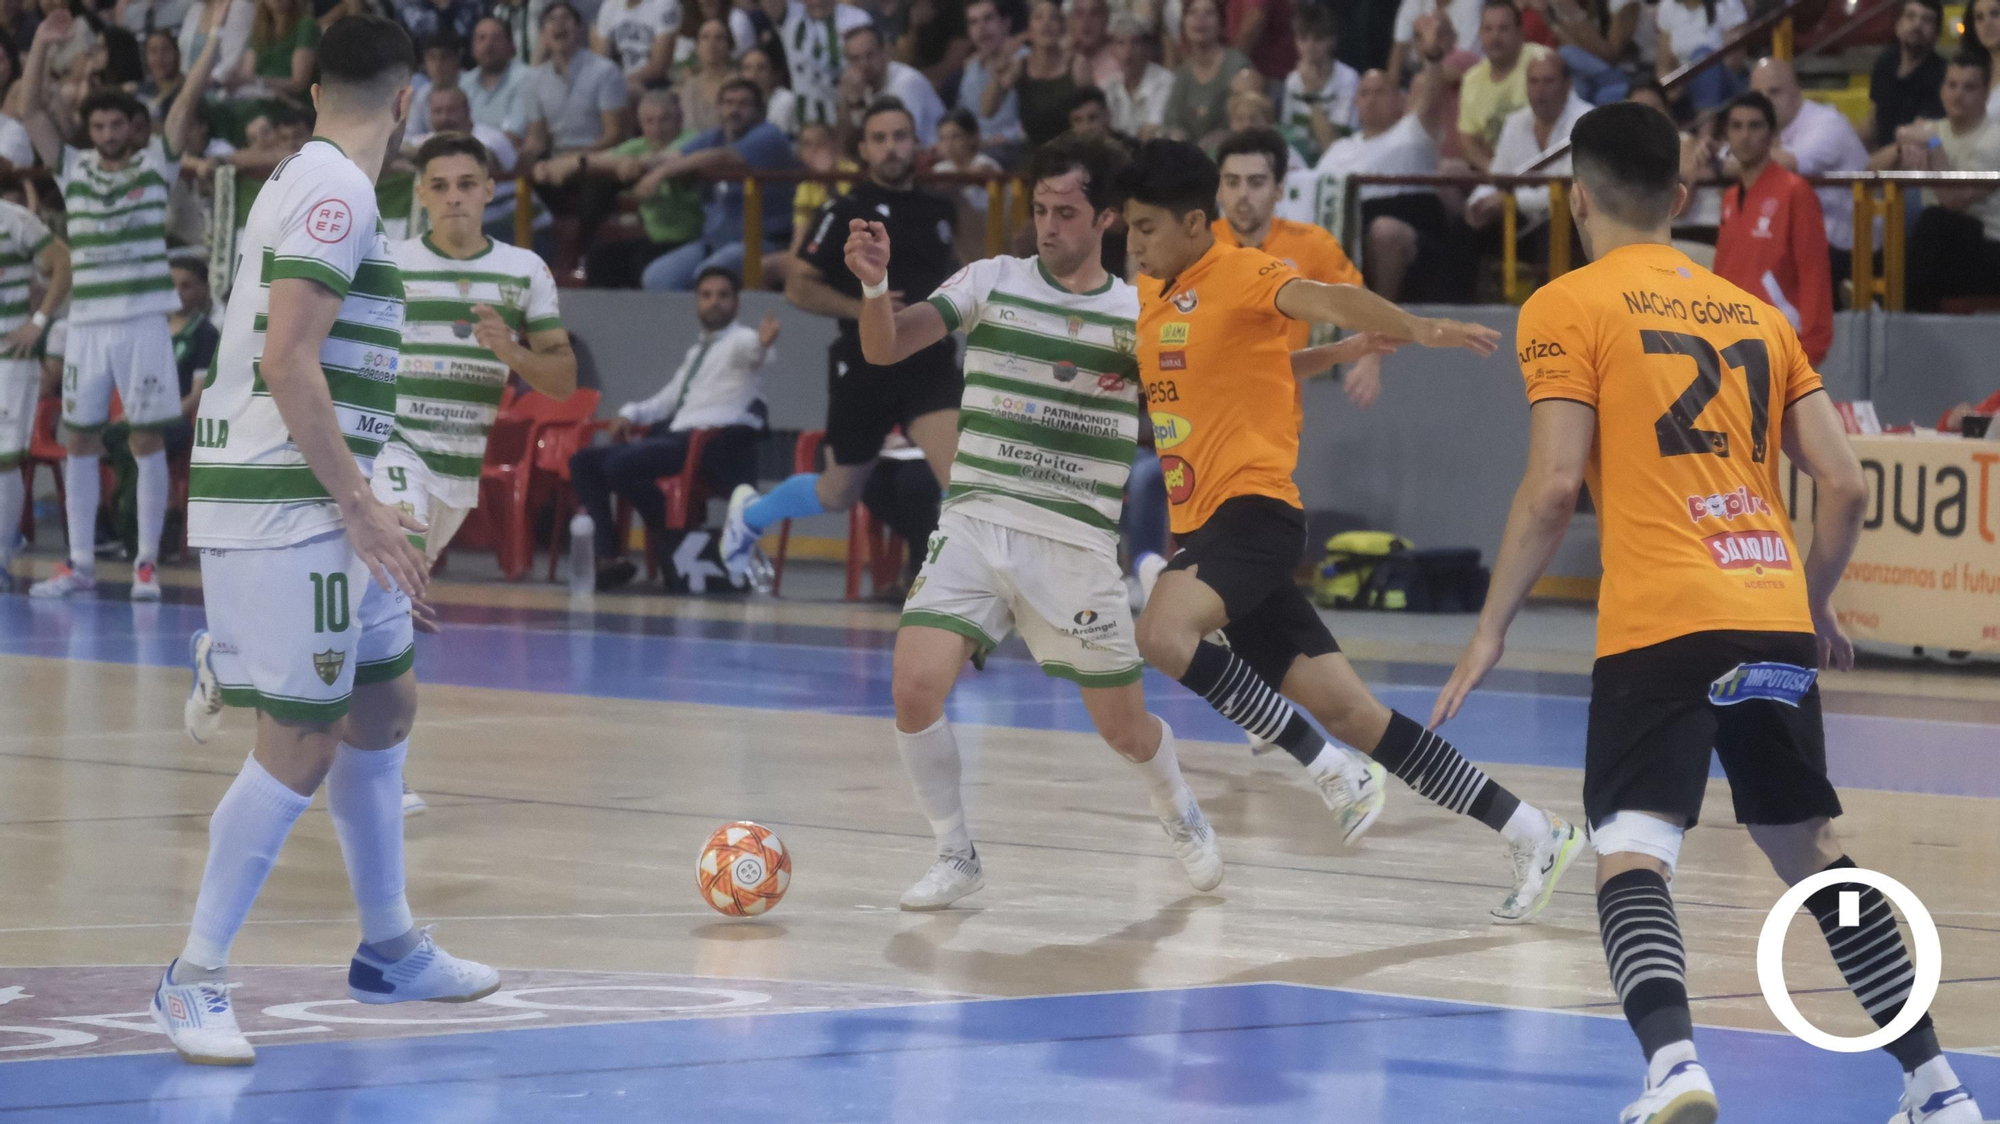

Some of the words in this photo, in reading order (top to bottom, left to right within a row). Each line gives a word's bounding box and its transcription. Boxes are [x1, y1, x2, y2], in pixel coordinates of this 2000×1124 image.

[1622, 290, 1687, 320] NACHO
[1691, 295, 1759, 326] GÓMEZ
[1639, 329, 1770, 464] 21
[1040, 416, 1119, 438] HUMANIDAD
[1043, 405, 1111, 427] PATRIMONIO
[1745, 580, 1785, 589] ACEITES
[310, 572, 349, 633] 10
[1744, 668, 1810, 692] IMPOTUSA
